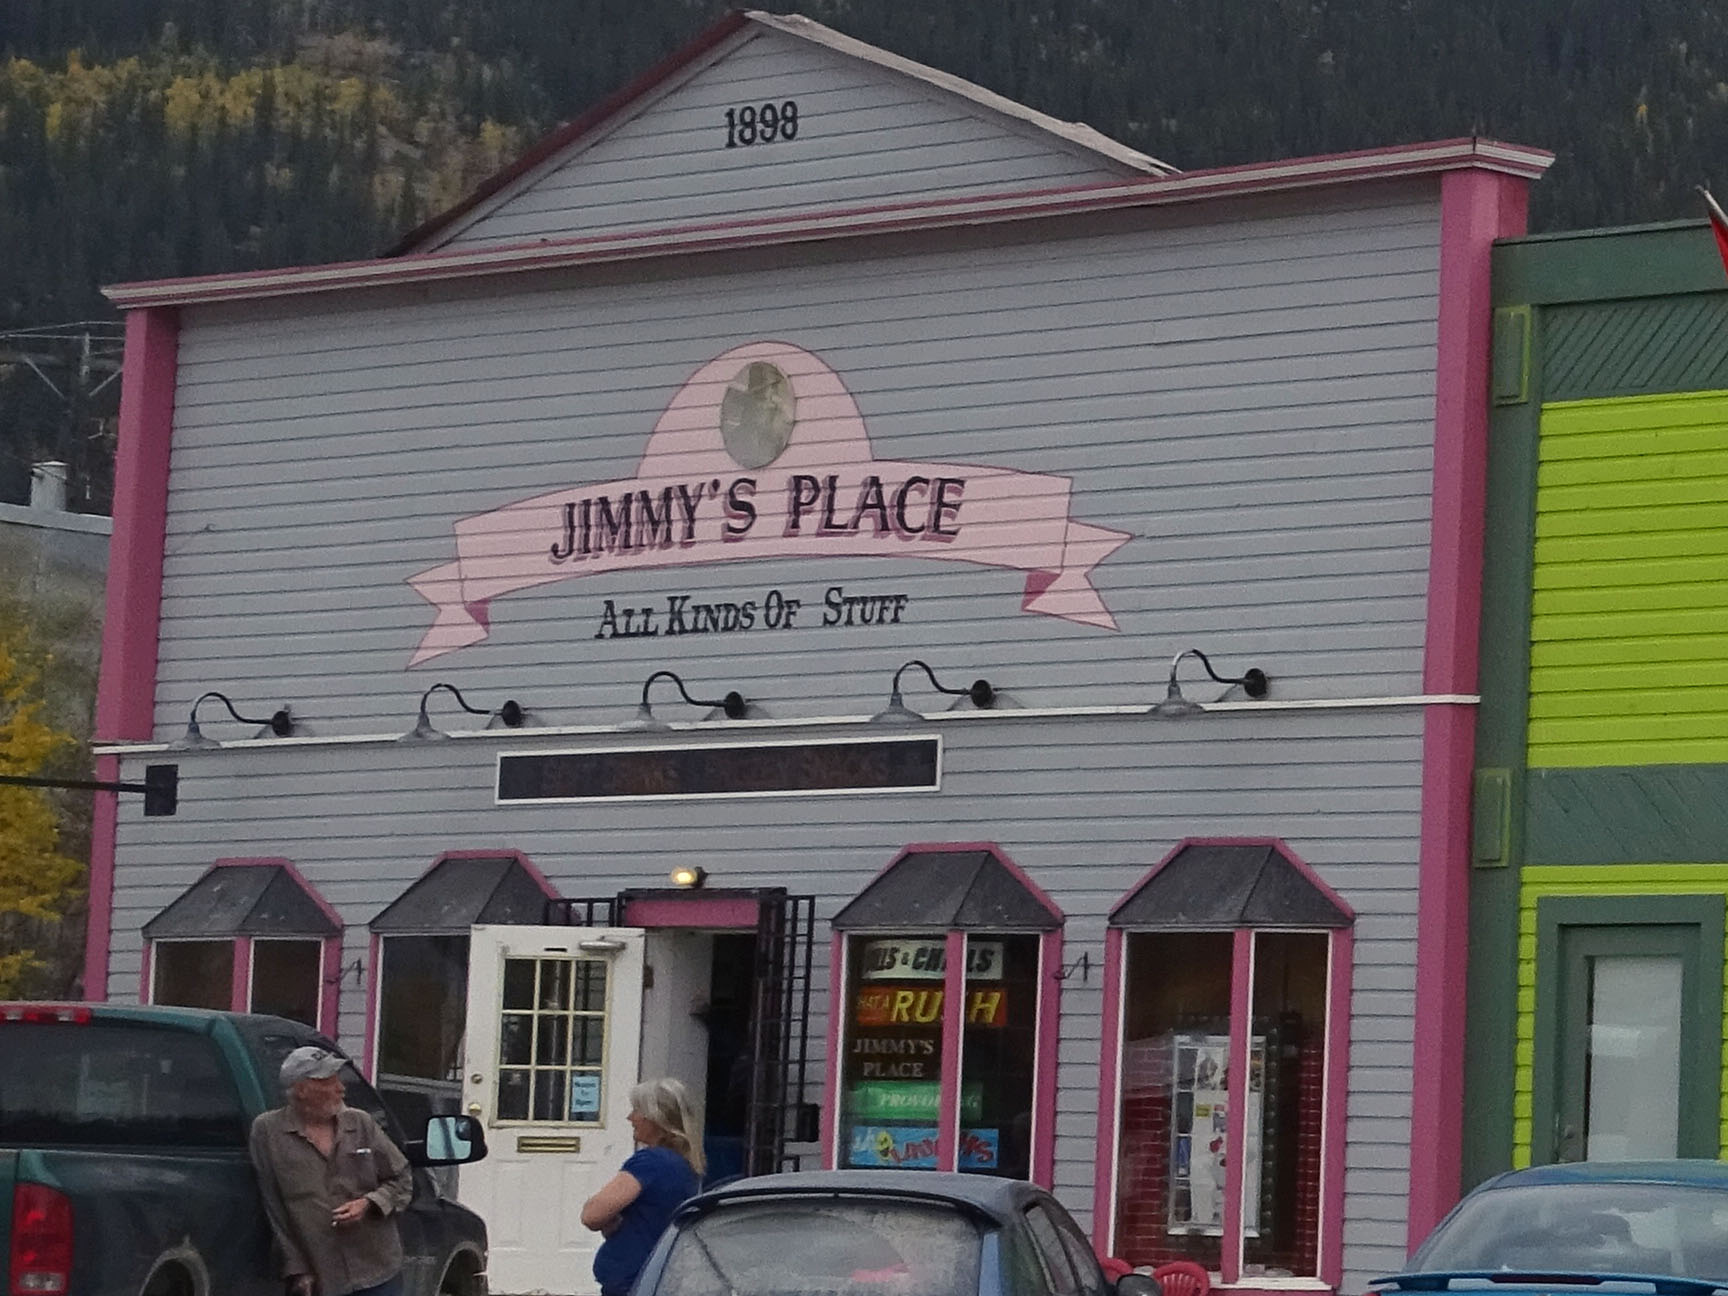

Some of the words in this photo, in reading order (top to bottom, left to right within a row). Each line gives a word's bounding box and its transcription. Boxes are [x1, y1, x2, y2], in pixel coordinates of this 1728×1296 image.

[725, 101, 798, 148] 1898
[550, 477, 757, 563] JIMMY'S
[783, 474, 967, 543] PLACE
[595, 600, 659, 639] ALL
[665, 595, 755, 635] KINDS
[822, 587, 908, 626] STUFF
[890, 990, 1001, 1025] RUH
[854, 1038, 934, 1055] JIMMY'S
[863, 1062, 924, 1078] PLACE
